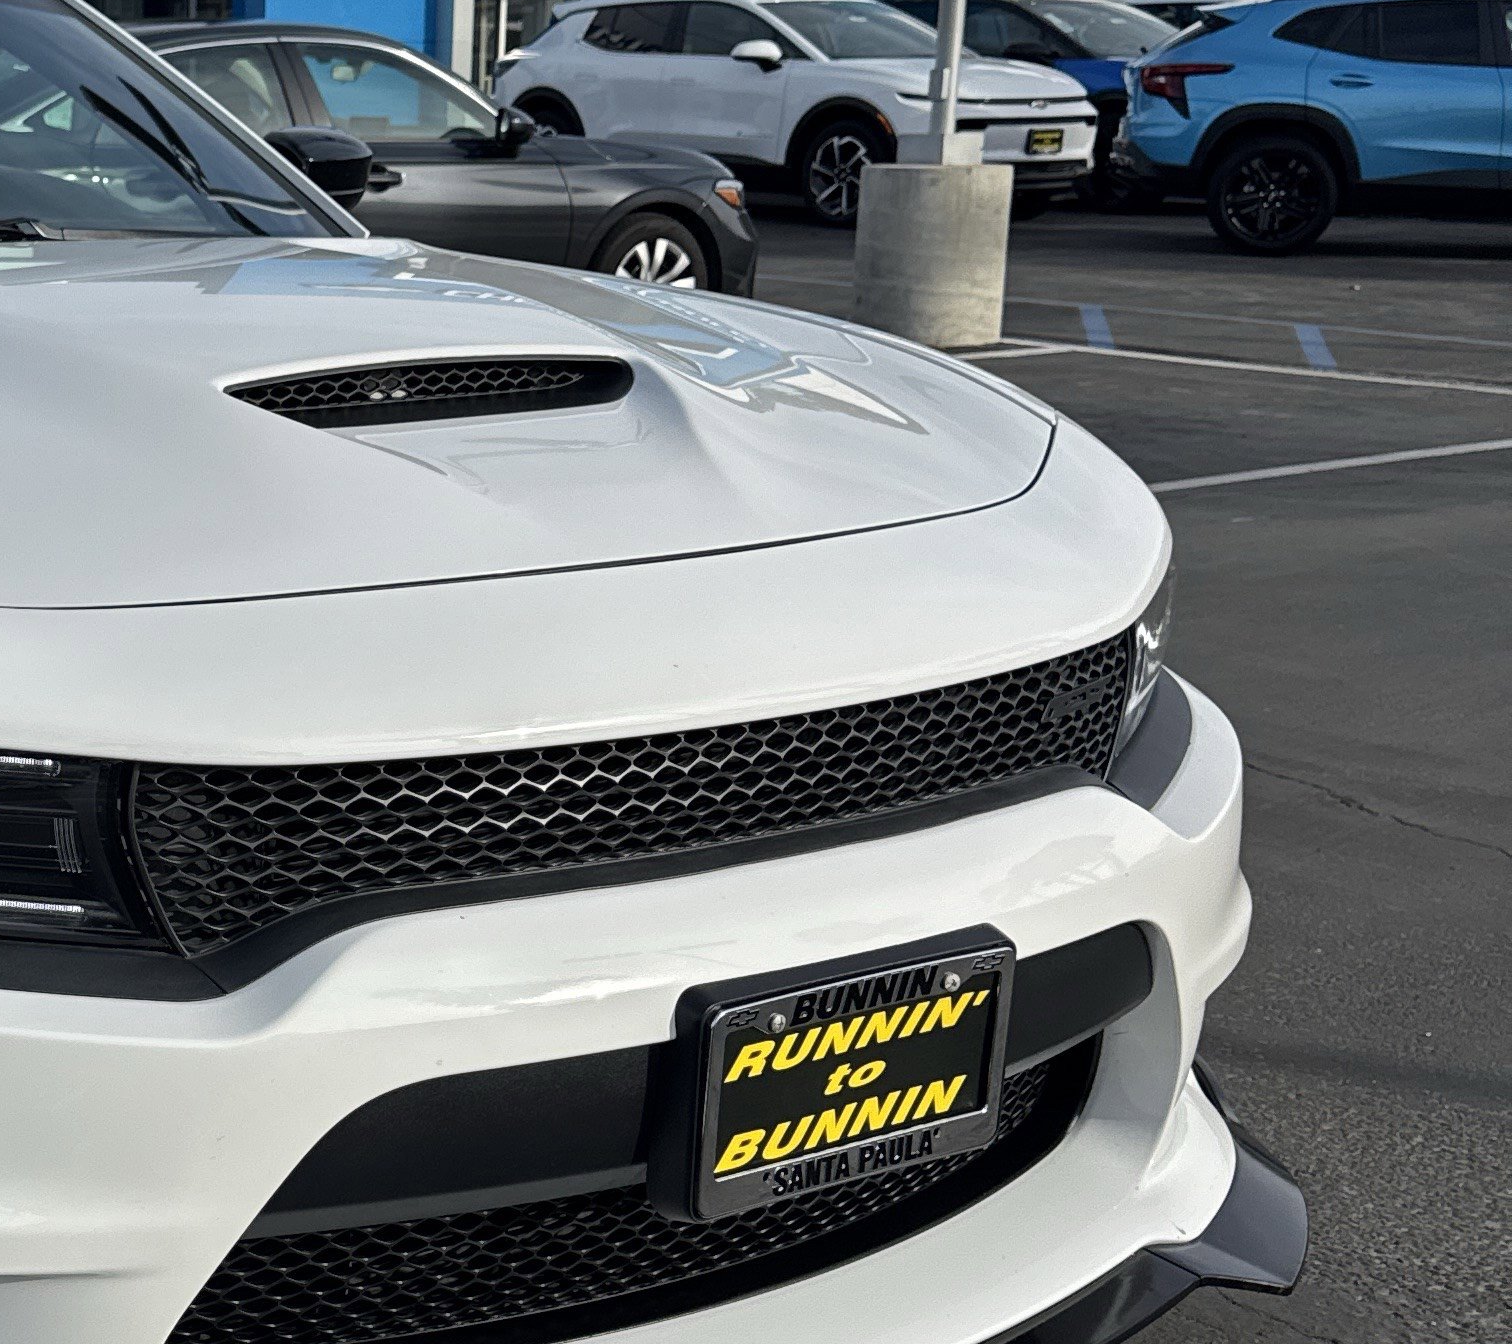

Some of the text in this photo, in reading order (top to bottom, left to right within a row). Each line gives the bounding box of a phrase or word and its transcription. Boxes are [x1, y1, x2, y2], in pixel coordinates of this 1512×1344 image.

[791, 964, 939, 1025] BUNNIN
[723, 989, 990, 1084] RUNNIN'
[823, 1060, 887, 1096] to
[713, 1074, 968, 1175] BUNNIN
